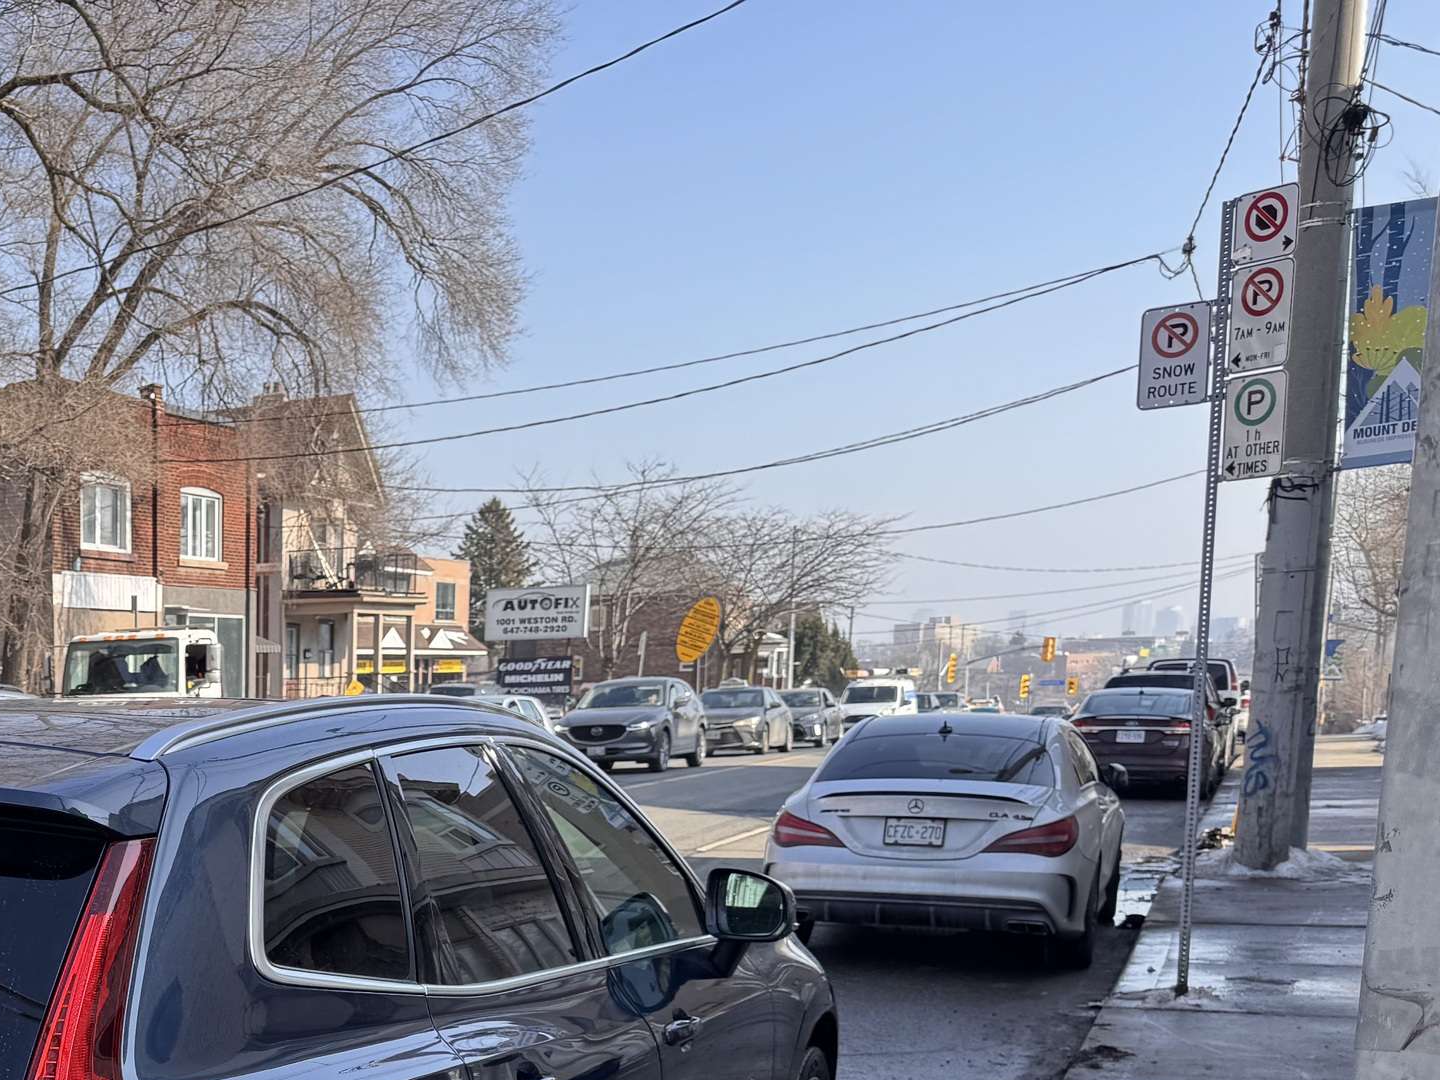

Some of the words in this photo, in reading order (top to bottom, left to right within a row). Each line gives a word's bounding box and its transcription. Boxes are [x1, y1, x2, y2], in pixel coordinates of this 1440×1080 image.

[1234, 326, 1253, 341] 7AM
[1265, 321, 1285, 335] 9AM
[1152, 363, 1196, 380] SNOW
[1147, 381, 1197, 399] ROUTE
[1352, 422, 1399, 440] MOUNT
[1226, 445, 1240, 459] AT
[1245, 440, 1280, 457] OTHER
[1237, 460, 1268, 478] TIMES
[502, 596, 580, 612] AUTOFIX
[496, 618, 516, 626] 1001
[519, 616, 558, 625] WESTON
[561, 615, 577, 623] RD.
[504, 673, 564, 684] MICHELIN
